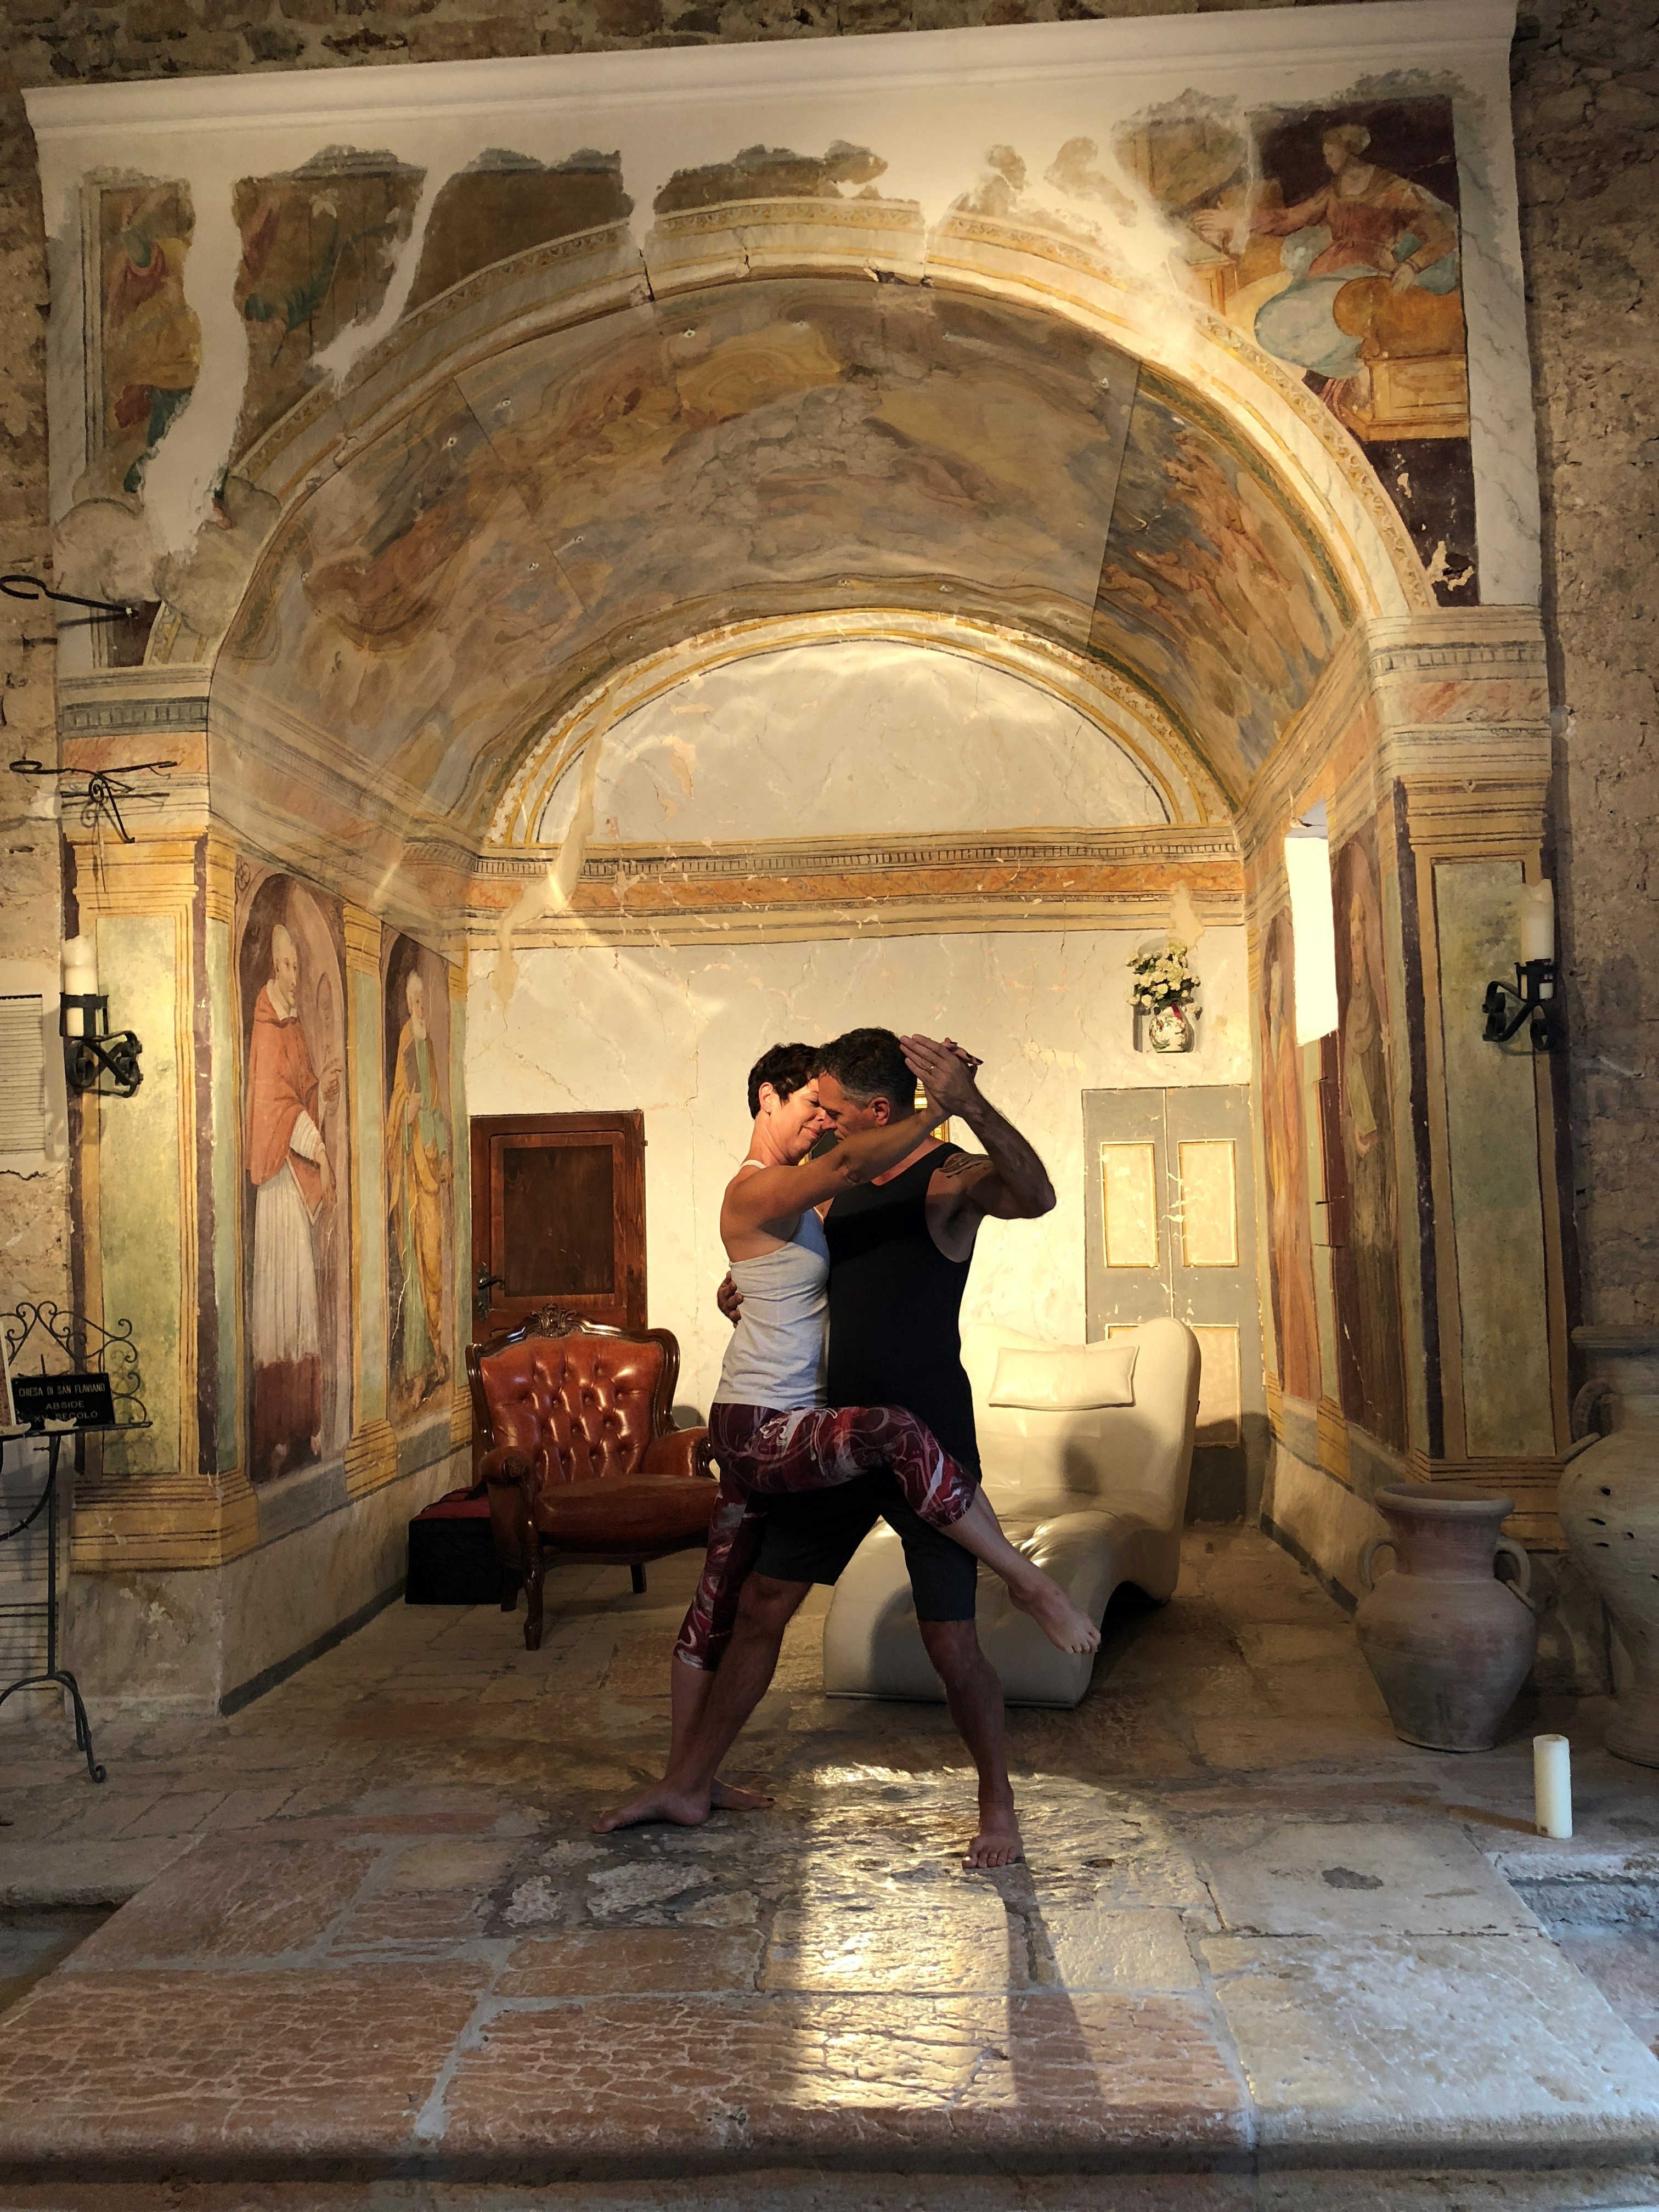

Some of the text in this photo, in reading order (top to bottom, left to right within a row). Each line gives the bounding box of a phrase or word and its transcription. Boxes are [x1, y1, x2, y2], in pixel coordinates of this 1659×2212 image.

[19, 1383, 105, 1397] CHIESA DI SAN FLAVIANO
[46, 1400, 84, 1410] ABSIDE
[55, 1410, 98, 1420] SECOLO
